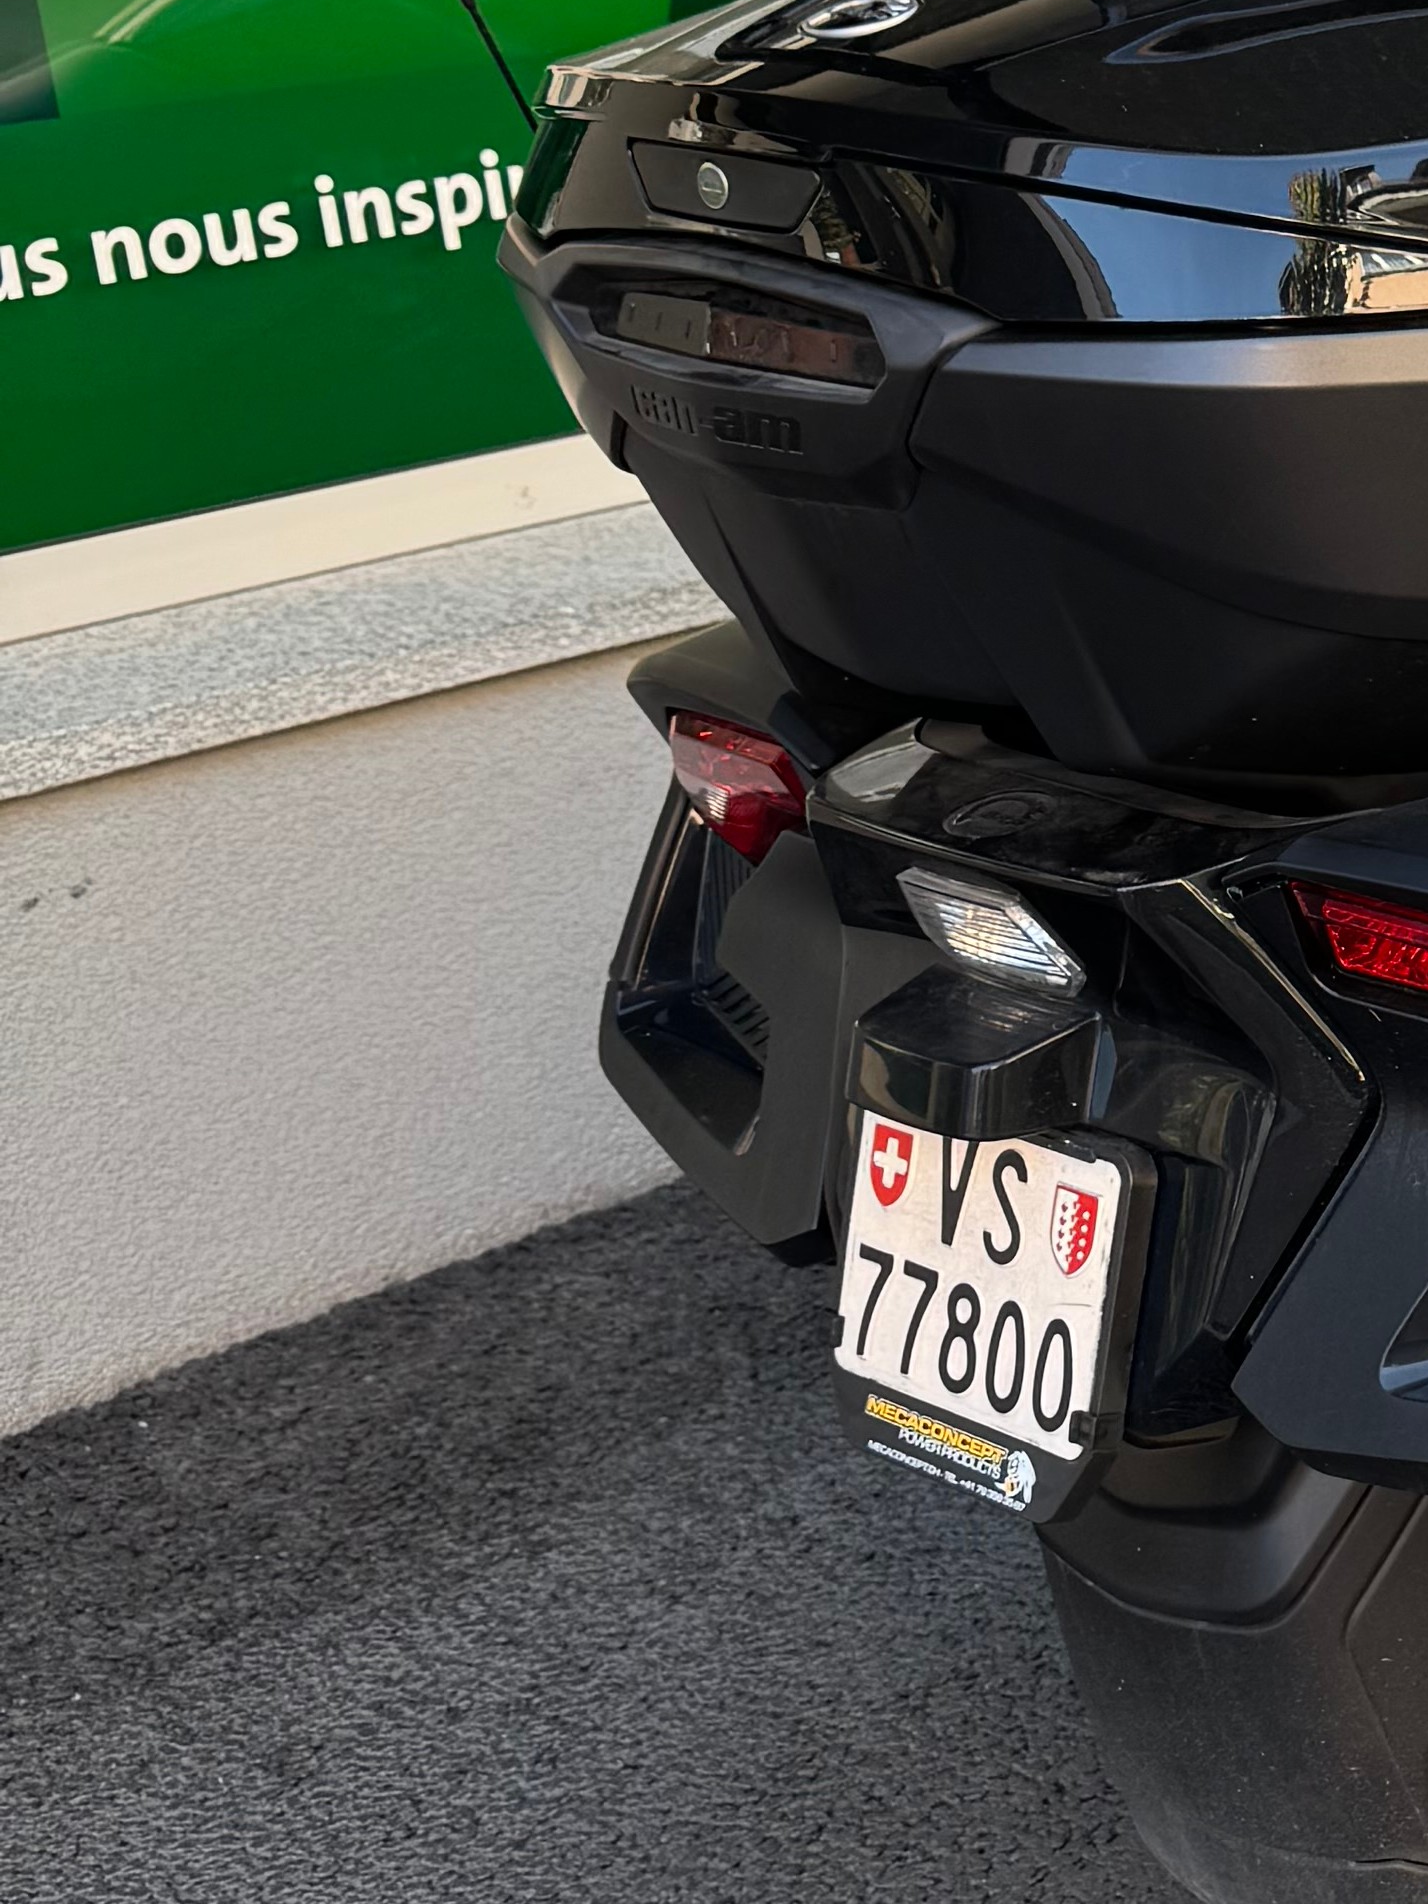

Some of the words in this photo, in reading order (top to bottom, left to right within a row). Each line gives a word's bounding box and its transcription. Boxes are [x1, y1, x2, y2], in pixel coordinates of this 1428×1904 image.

[90, 200, 299, 285] nous
[629, 384, 804, 456] can-am
[941, 1135, 1028, 1265] VS
[856, 1243, 1073, 1432] 77800
[865, 1394, 1008, 1465] MECACONCEPT
[940, 1443, 1001, 1479] PRODUCTS
